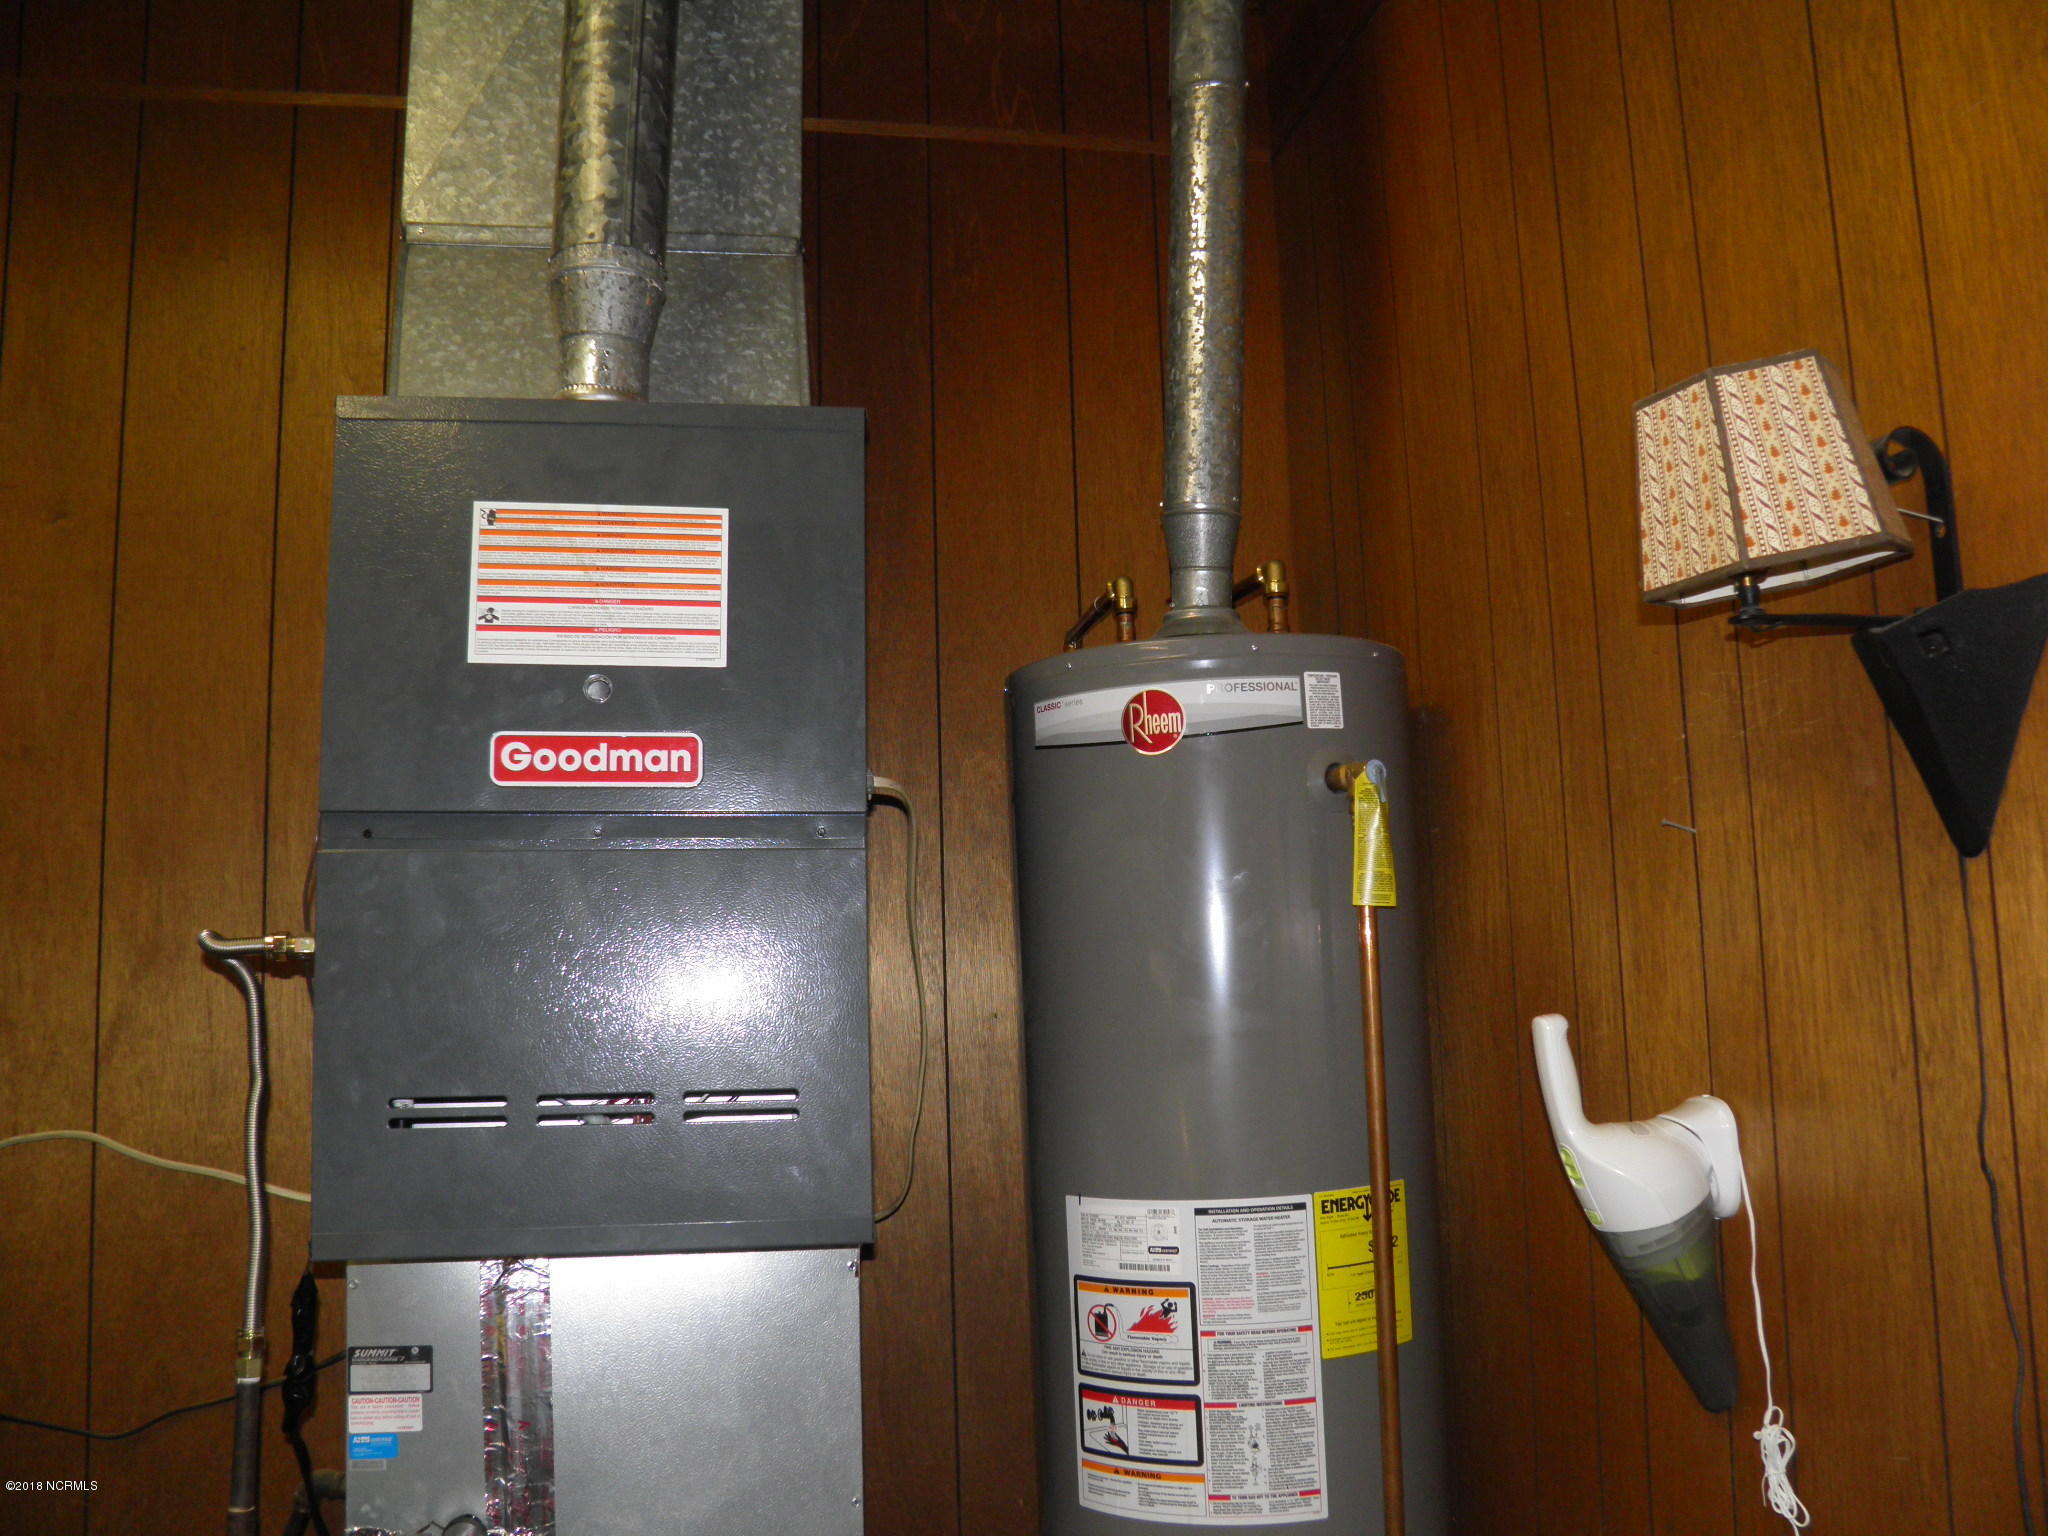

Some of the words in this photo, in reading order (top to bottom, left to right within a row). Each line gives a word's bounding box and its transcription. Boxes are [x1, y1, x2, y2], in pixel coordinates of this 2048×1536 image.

[1129, 691, 1182, 743] Rheem
[500, 741, 692, 772] Goodman
[1112, 1286, 1154, 1296] WARNING
[354, 1348, 397, 1358] SUMMIT
[1121, 1396, 1156, 1407] DANGER
[1124, 1468, 1161, 1480] WARNING
